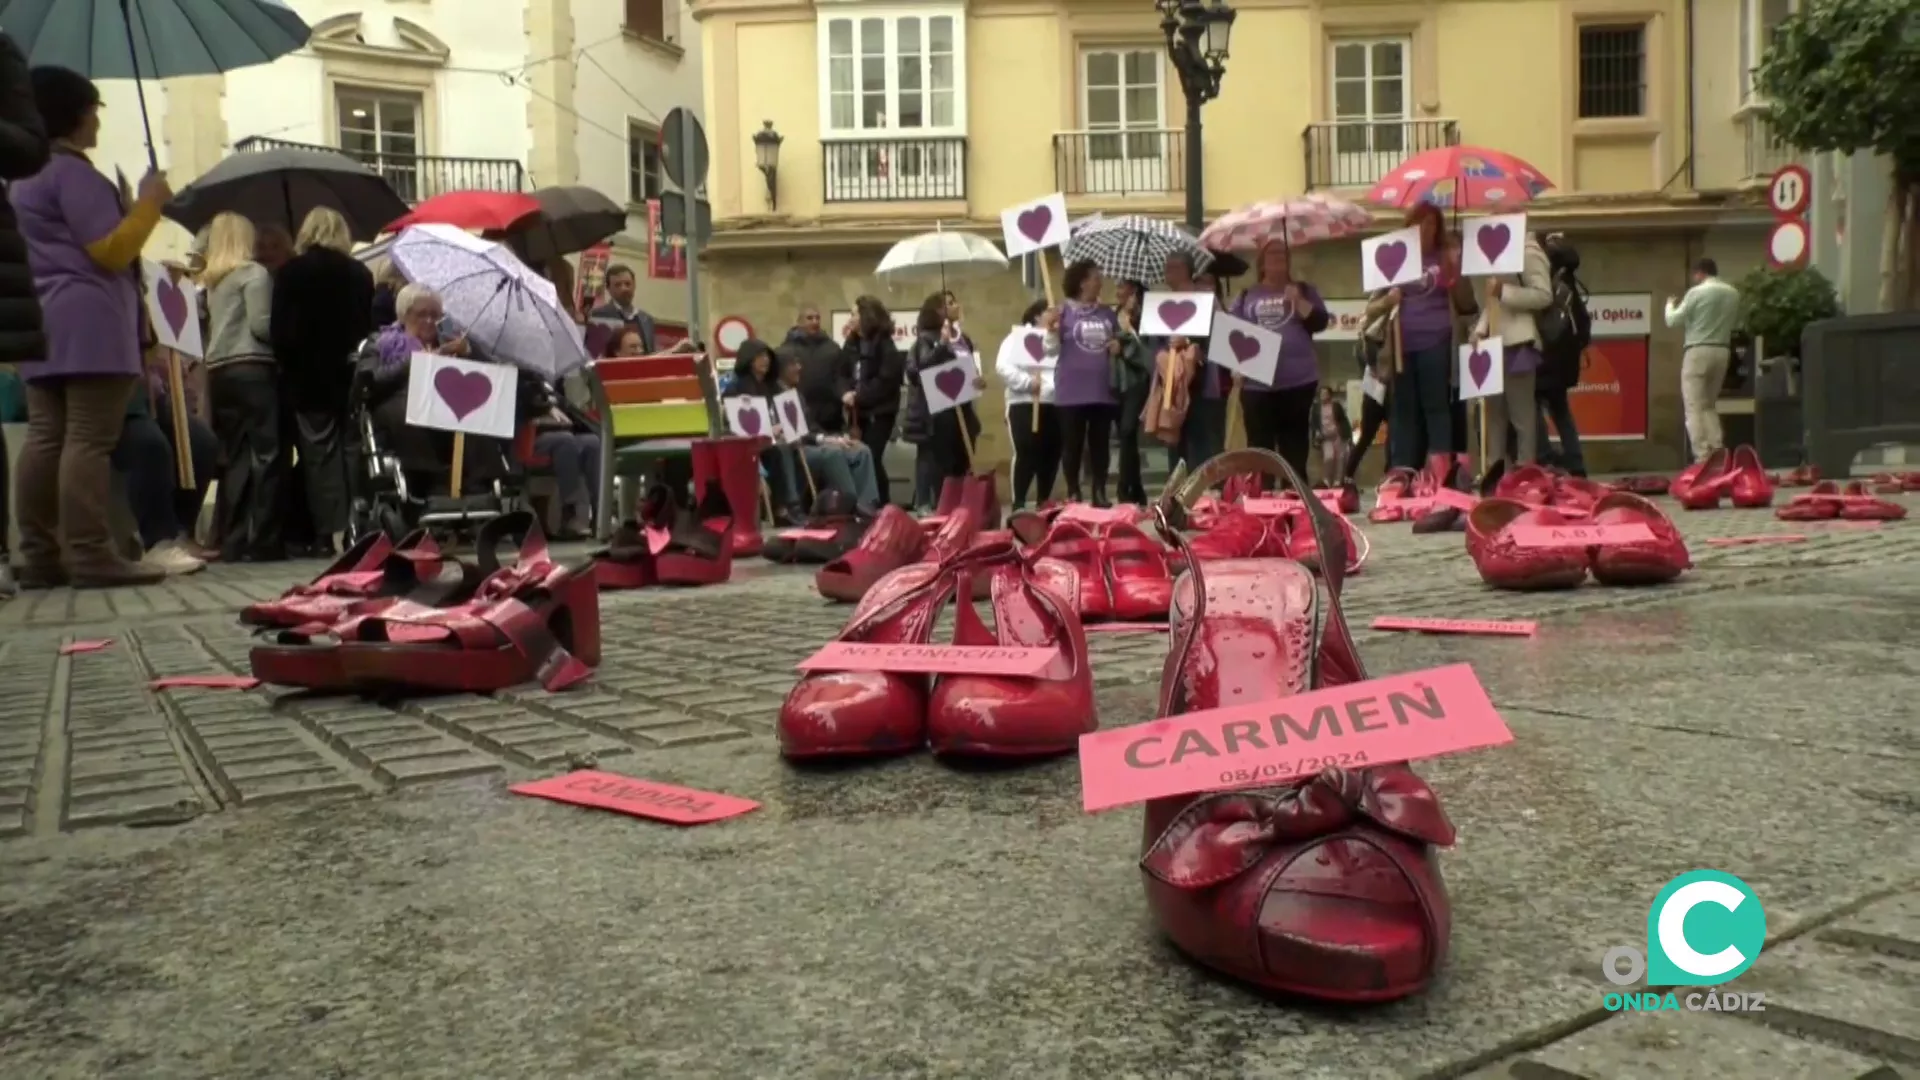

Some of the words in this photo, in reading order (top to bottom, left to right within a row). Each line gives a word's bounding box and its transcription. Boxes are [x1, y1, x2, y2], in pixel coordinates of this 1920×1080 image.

[841, 647, 881, 657] NO
[887, 647, 1029, 660] CONOCIDO
[1123, 686, 1446, 769] CARMEN
[1219, 749, 1369, 784] 08/05/2024
